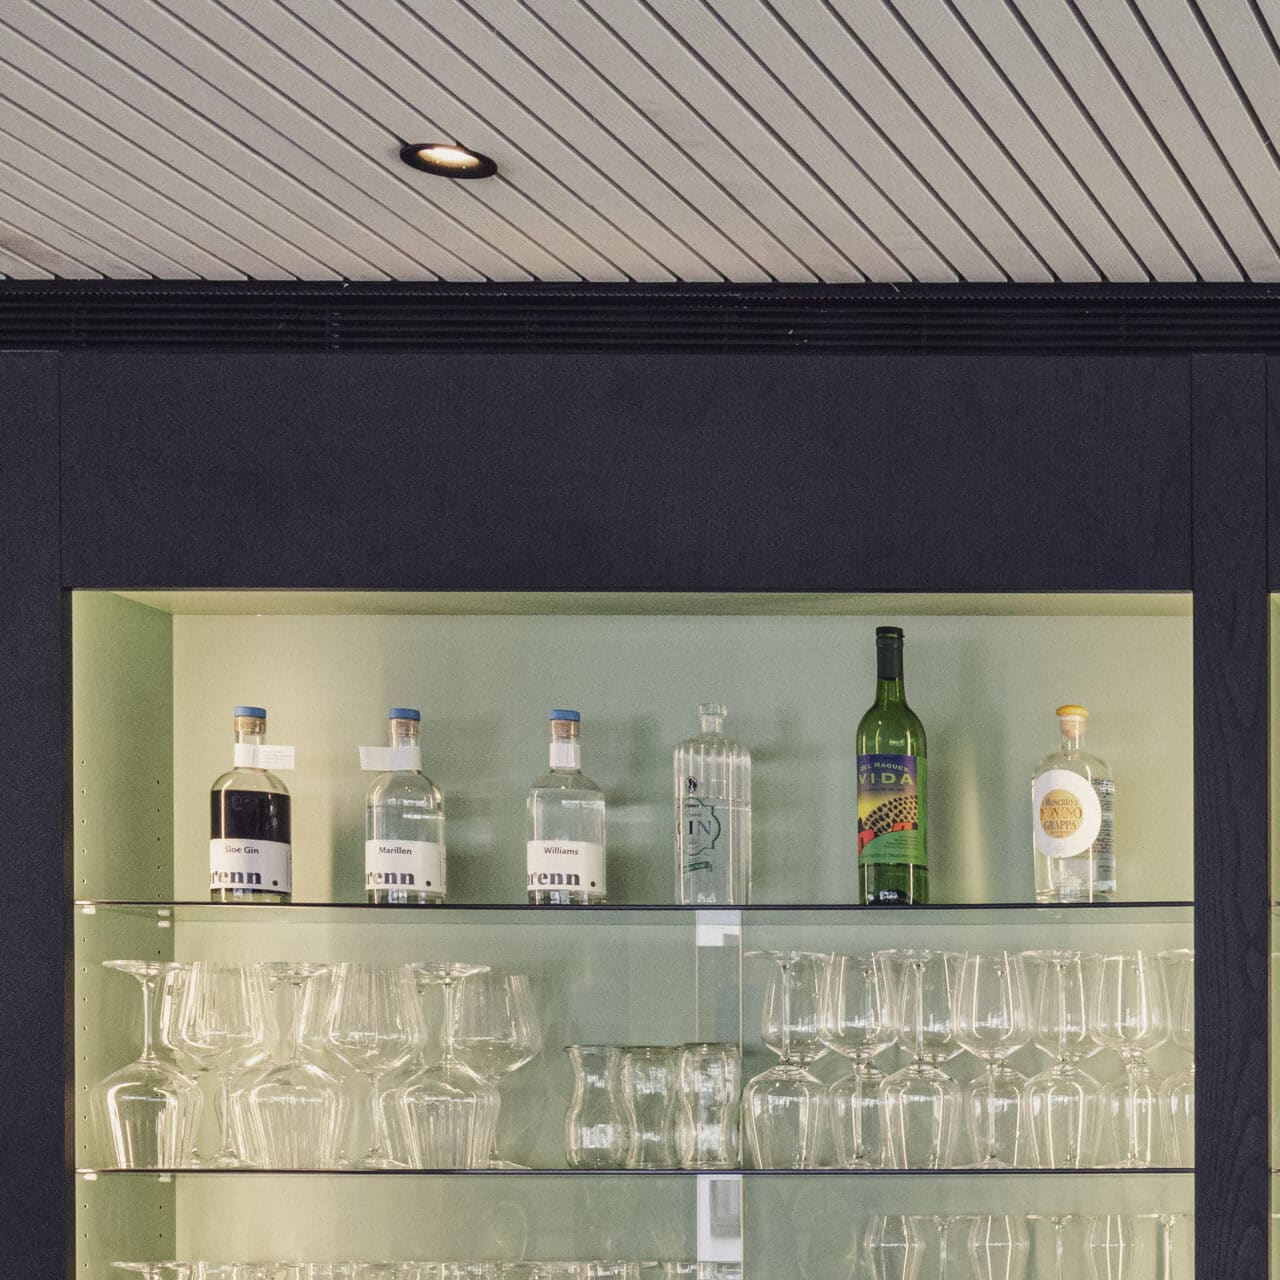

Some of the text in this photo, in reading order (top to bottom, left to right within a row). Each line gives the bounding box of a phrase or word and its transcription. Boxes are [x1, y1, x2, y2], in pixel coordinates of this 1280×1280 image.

[858, 772, 914, 786] VIDA
[1043, 819, 1078, 831] GRAPPA
[225, 845, 260, 855] Sloe Gin
[379, 846, 413, 856] Marillen
[543, 846, 580, 856] Williams
